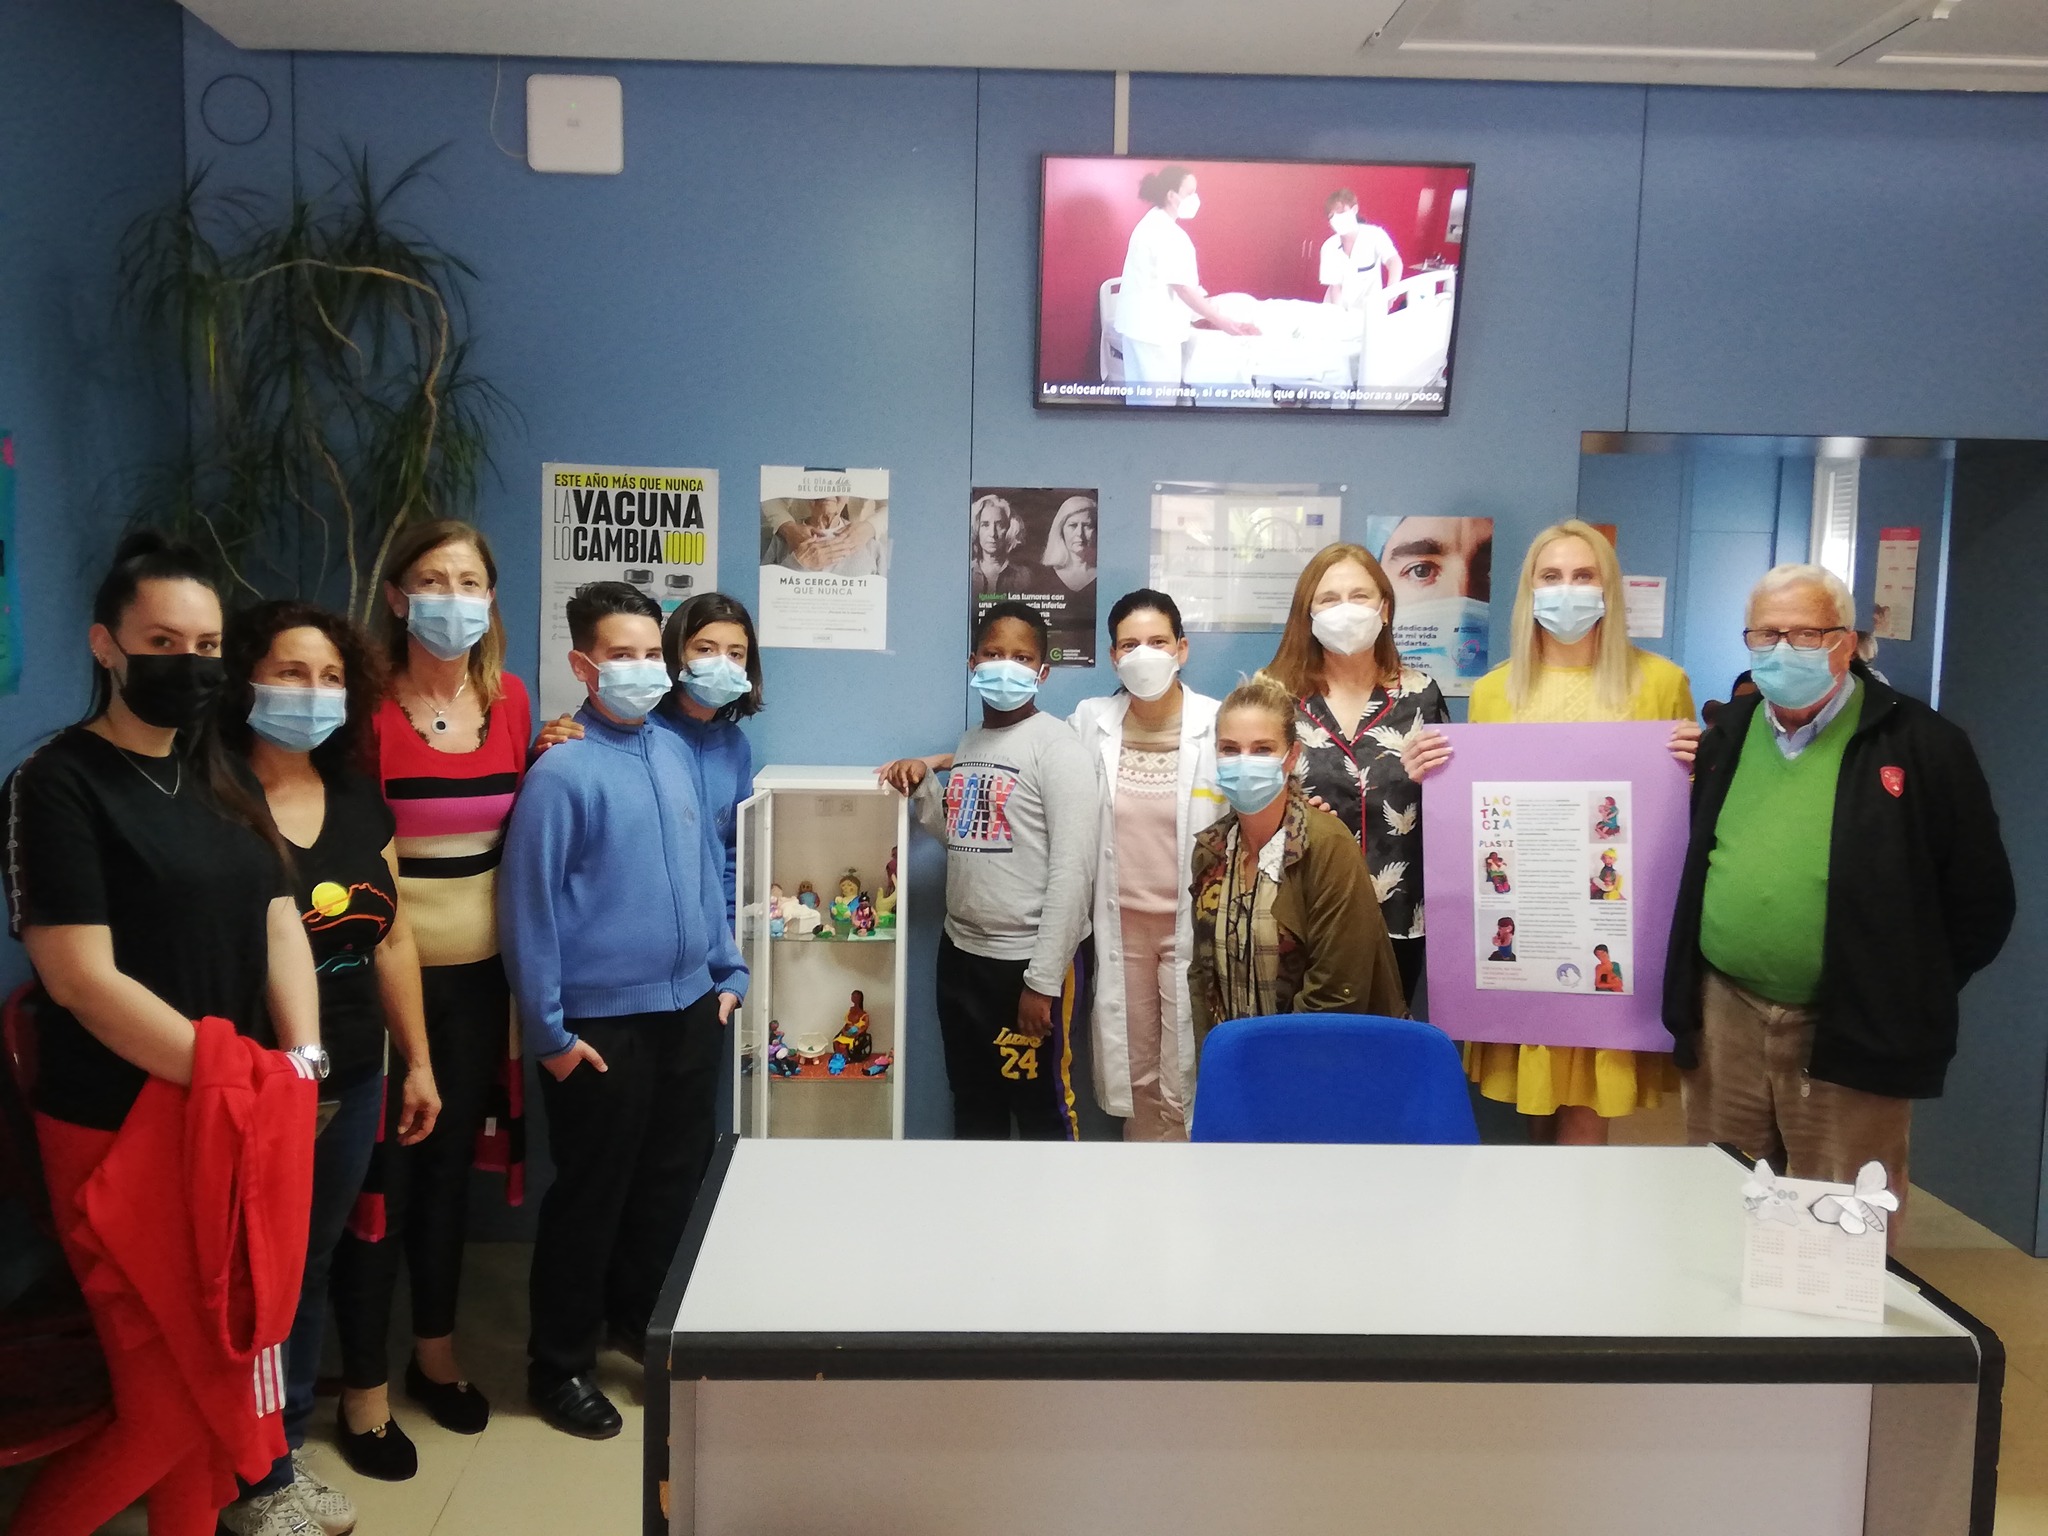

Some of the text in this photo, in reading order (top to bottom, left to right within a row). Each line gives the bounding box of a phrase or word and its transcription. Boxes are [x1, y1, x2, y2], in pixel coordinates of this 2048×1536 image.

[1043, 382, 1057, 395] Le
[1059, 383, 1133, 396] colocaríamos
[1136, 385, 1152, 396] las
[1155, 385, 1199, 399] piernas,
[1202, 386, 1212, 398] si
[1214, 388, 1228, 398] es
[1231, 387, 1272, 400] posible
[1274, 389, 1295, 402] que
[1310, 390, 1330, 400] nos
[1333, 388, 1391, 401] colaborara
[1394, 391, 1409, 401] un
[1411, 391, 1443, 403] poco,
[555, 473, 704, 492] ESTE AÑO MÁS QUE NUNCA
[553, 489, 704, 529] LA VACUNA
[553, 526, 705, 566] LO CAMBIA TODO
[780, 576, 801, 586] MÁS
[804, 578, 838, 587] CERCA
[842, 579, 855, 587] DE
[793, 586, 853, 596] QUE NUNCA
[1021, 592, 1050, 600] tumores
[1041, 601, 1067, 609] inferior
[1479, 840, 1514, 848] PLASTI
[1000, 1046, 1038, 1080] 24
